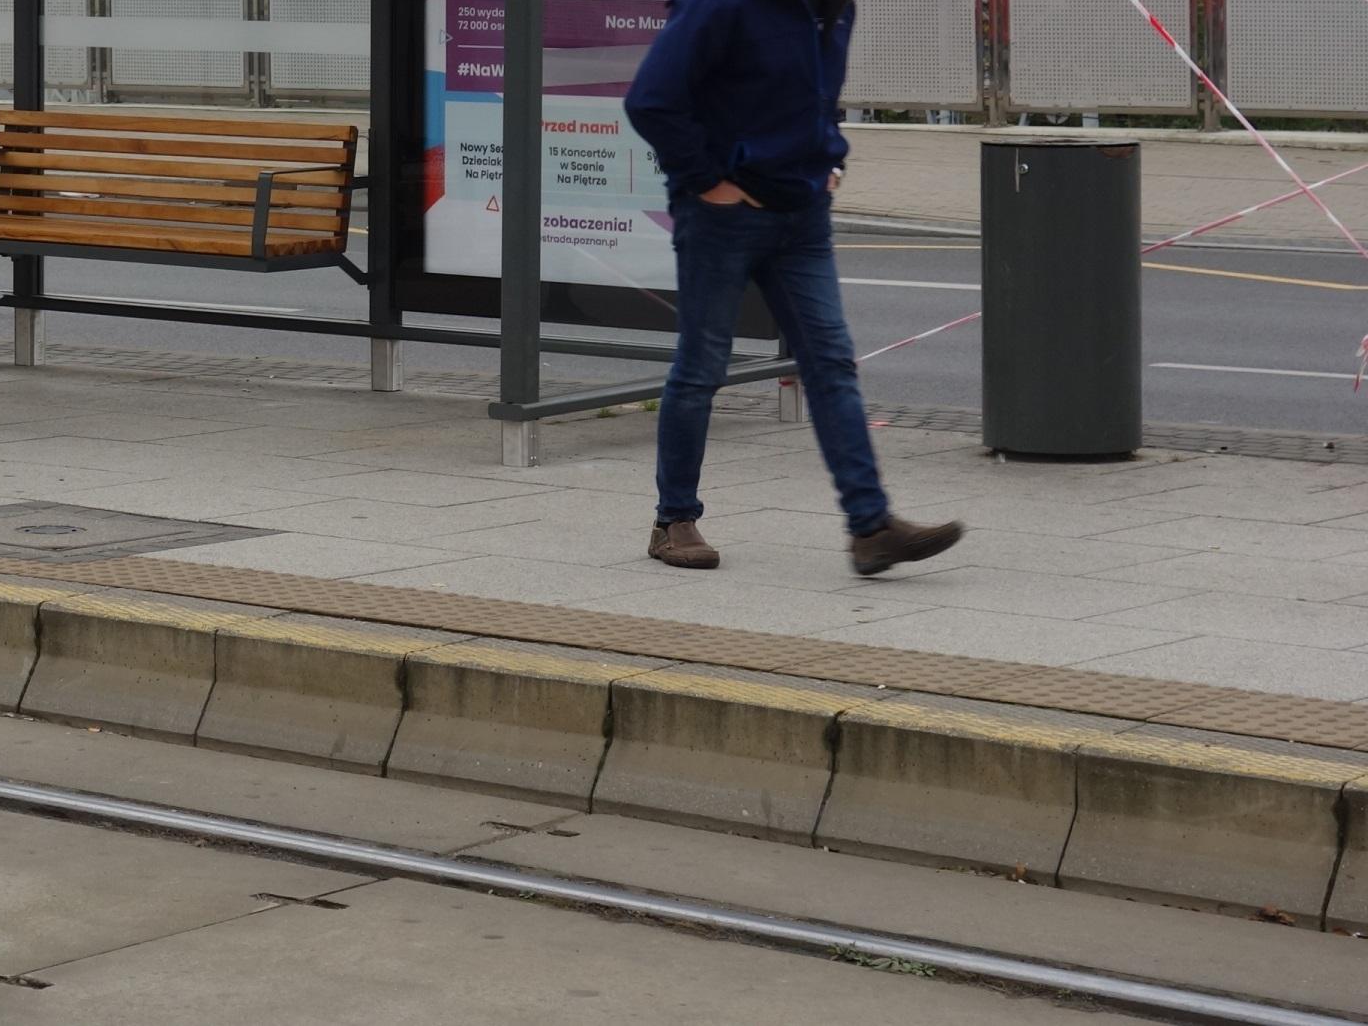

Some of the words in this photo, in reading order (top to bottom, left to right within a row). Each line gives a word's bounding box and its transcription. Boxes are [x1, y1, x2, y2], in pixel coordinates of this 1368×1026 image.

[458, 7, 475, 17] 250
[477, 8, 505, 19] wyda
[457, 20, 468, 30] 72
[469, 20, 489, 30] 000
[490, 22, 505, 31] os
[605, 15, 636, 29] Noc
[638, 16, 667, 30] Muz
[457, 62, 505, 77] #NaW
[580, 120, 619, 135] nami
[460, 142, 488, 155] Nowy
[549, 146, 559, 156] 15
[560, 147, 616, 159] Koncertów
[462, 155, 503, 167] Dzieciak
[560, 162, 569, 170] w
[570, 161, 605, 172] Scenie
[465, 169, 479, 179] Na
[480, 170, 503, 181] Piętr
[557, 173, 571, 184] Na
[573, 174, 607, 186] Piętrze
[543, 215, 633, 233] zobaczenia!
[540, 234, 618, 249] strada.poznan.pl
